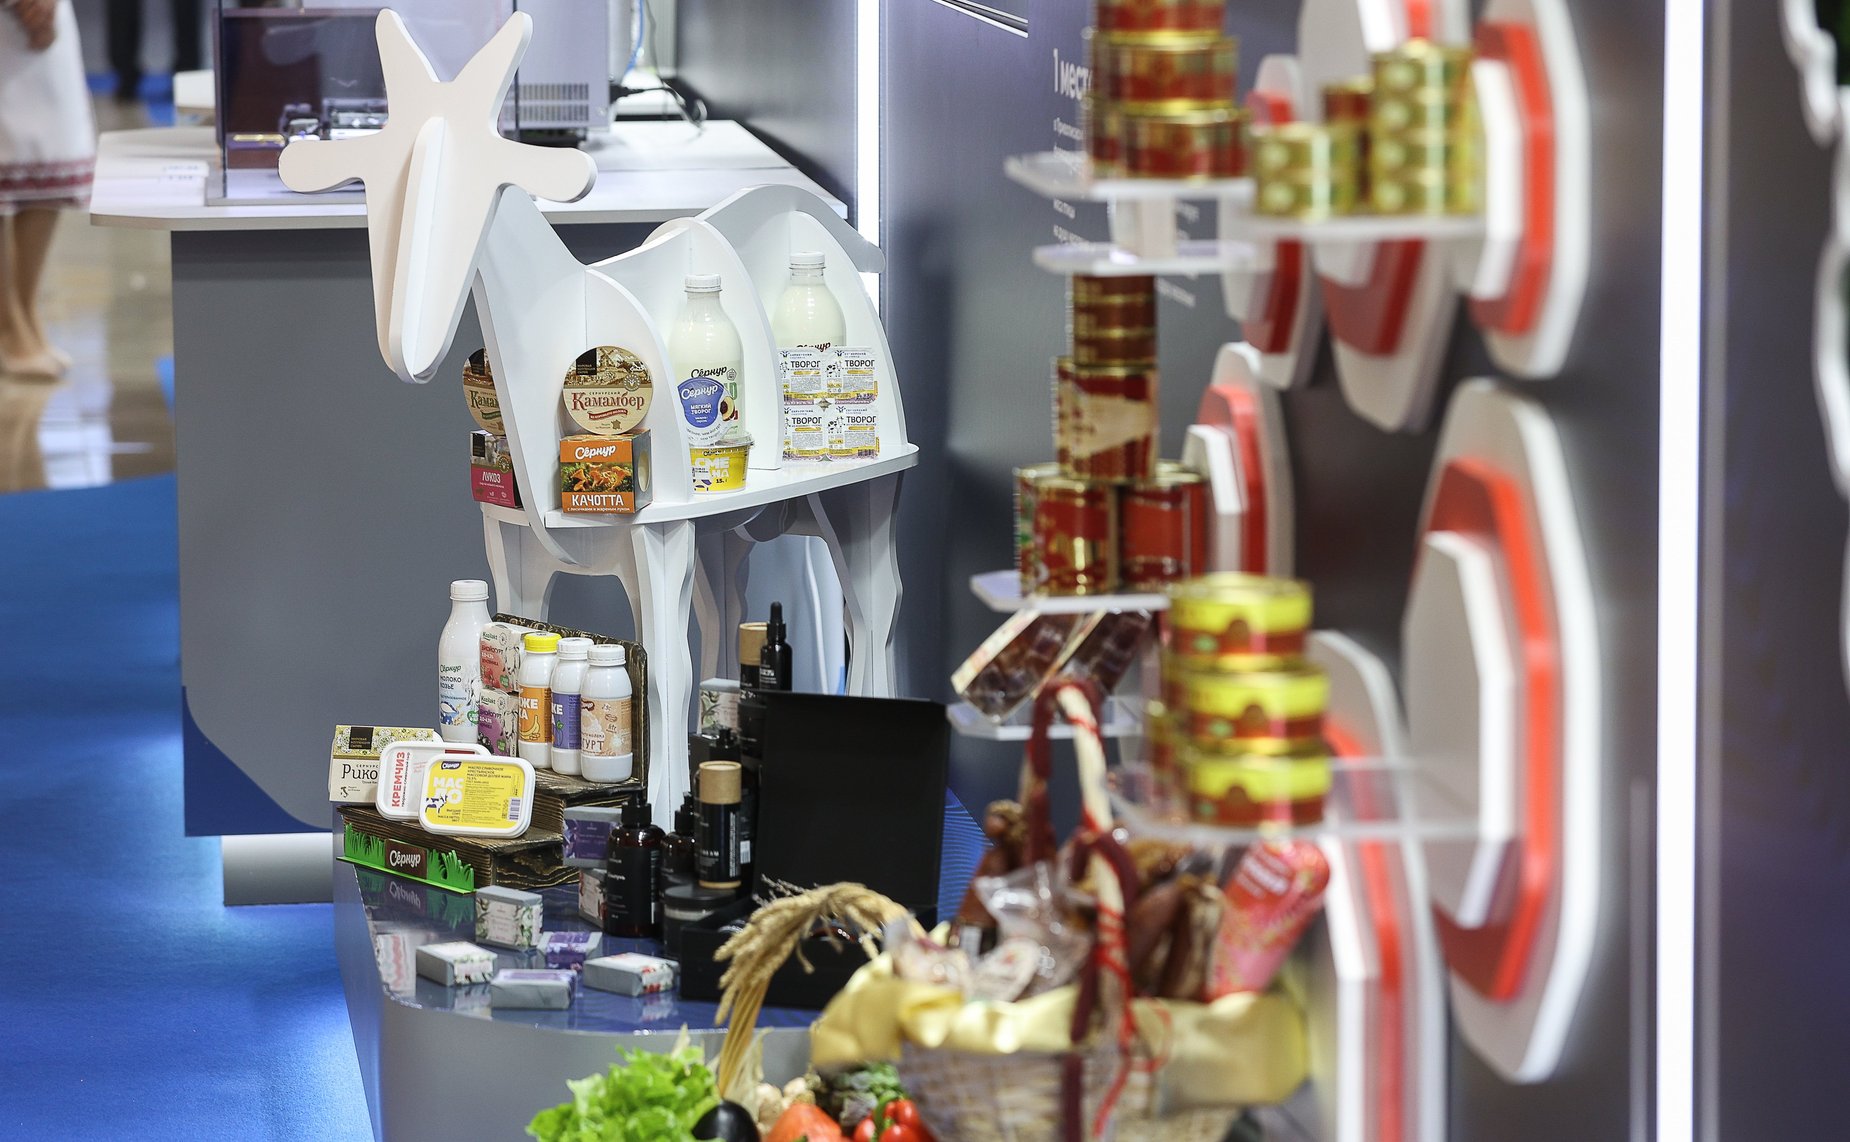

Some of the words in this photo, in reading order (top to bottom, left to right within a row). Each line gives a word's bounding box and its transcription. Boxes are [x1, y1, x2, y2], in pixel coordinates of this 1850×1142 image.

[790, 360, 821, 368] ТВОРОГ
[844, 359, 875, 367] ТВОРОГ
[571, 391, 645, 411] Камамбер
[571, 494, 624, 506] КАЧОТТА
[341, 763, 379, 780] Рико
[392, 752, 406, 807] КРЕМЧИЗ
[433, 777, 464, 789] МАС
